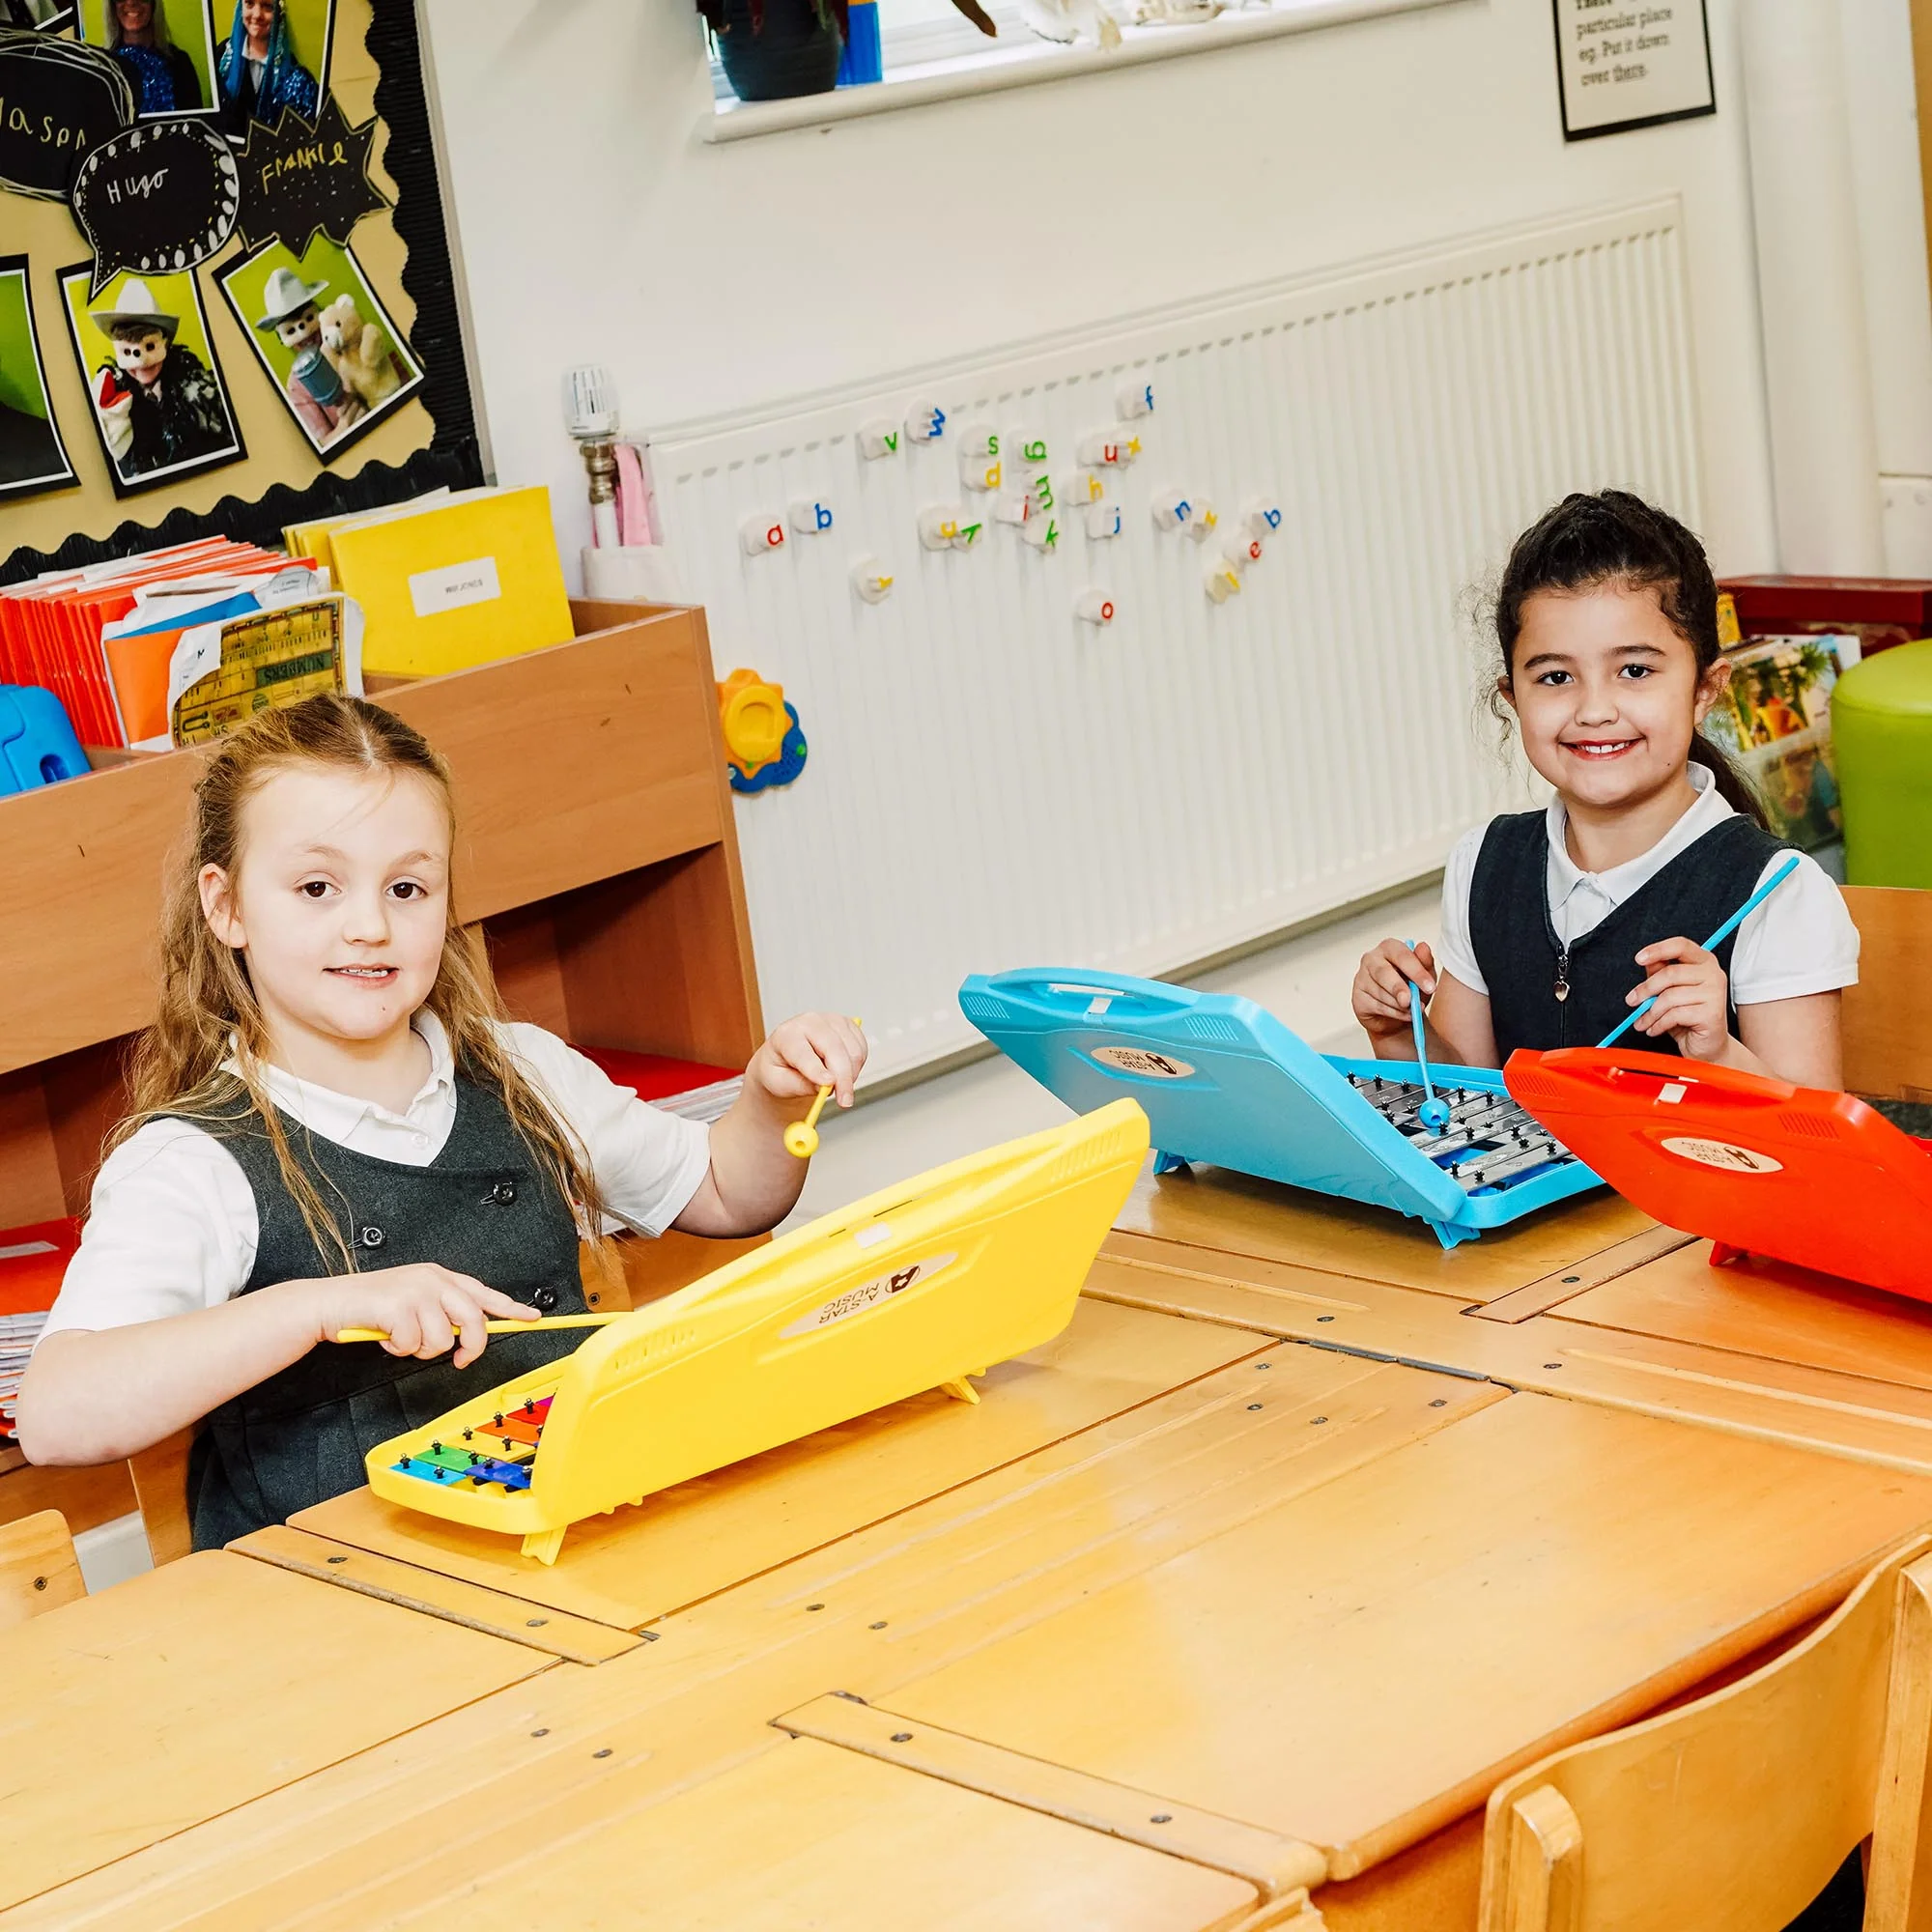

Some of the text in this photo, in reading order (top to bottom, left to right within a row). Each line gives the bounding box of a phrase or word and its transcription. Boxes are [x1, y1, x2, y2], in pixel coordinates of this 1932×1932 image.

[1577, 8, 1673, 41] particular place
[1602, 41, 1622, 58] Put
[1625, 38, 1634, 53] it
[1636, 34, 1670, 51] down
[1580, 71, 1609, 87] over
[0, 97, 86, 151] ason
[988, 436, 999, 455] s
[1104, 444, 1119, 463] u
[985, 461, 1001, 489] d
[815, 502, 833, 529] b
[766, 525, 784, 547] a
[1101, 602, 1114, 620] o
[263, 653, 326, 682] NUMBERS
[819, 1290, 879, 1323] A-STAR
[824, 1283, 879, 1313] MUSIC
